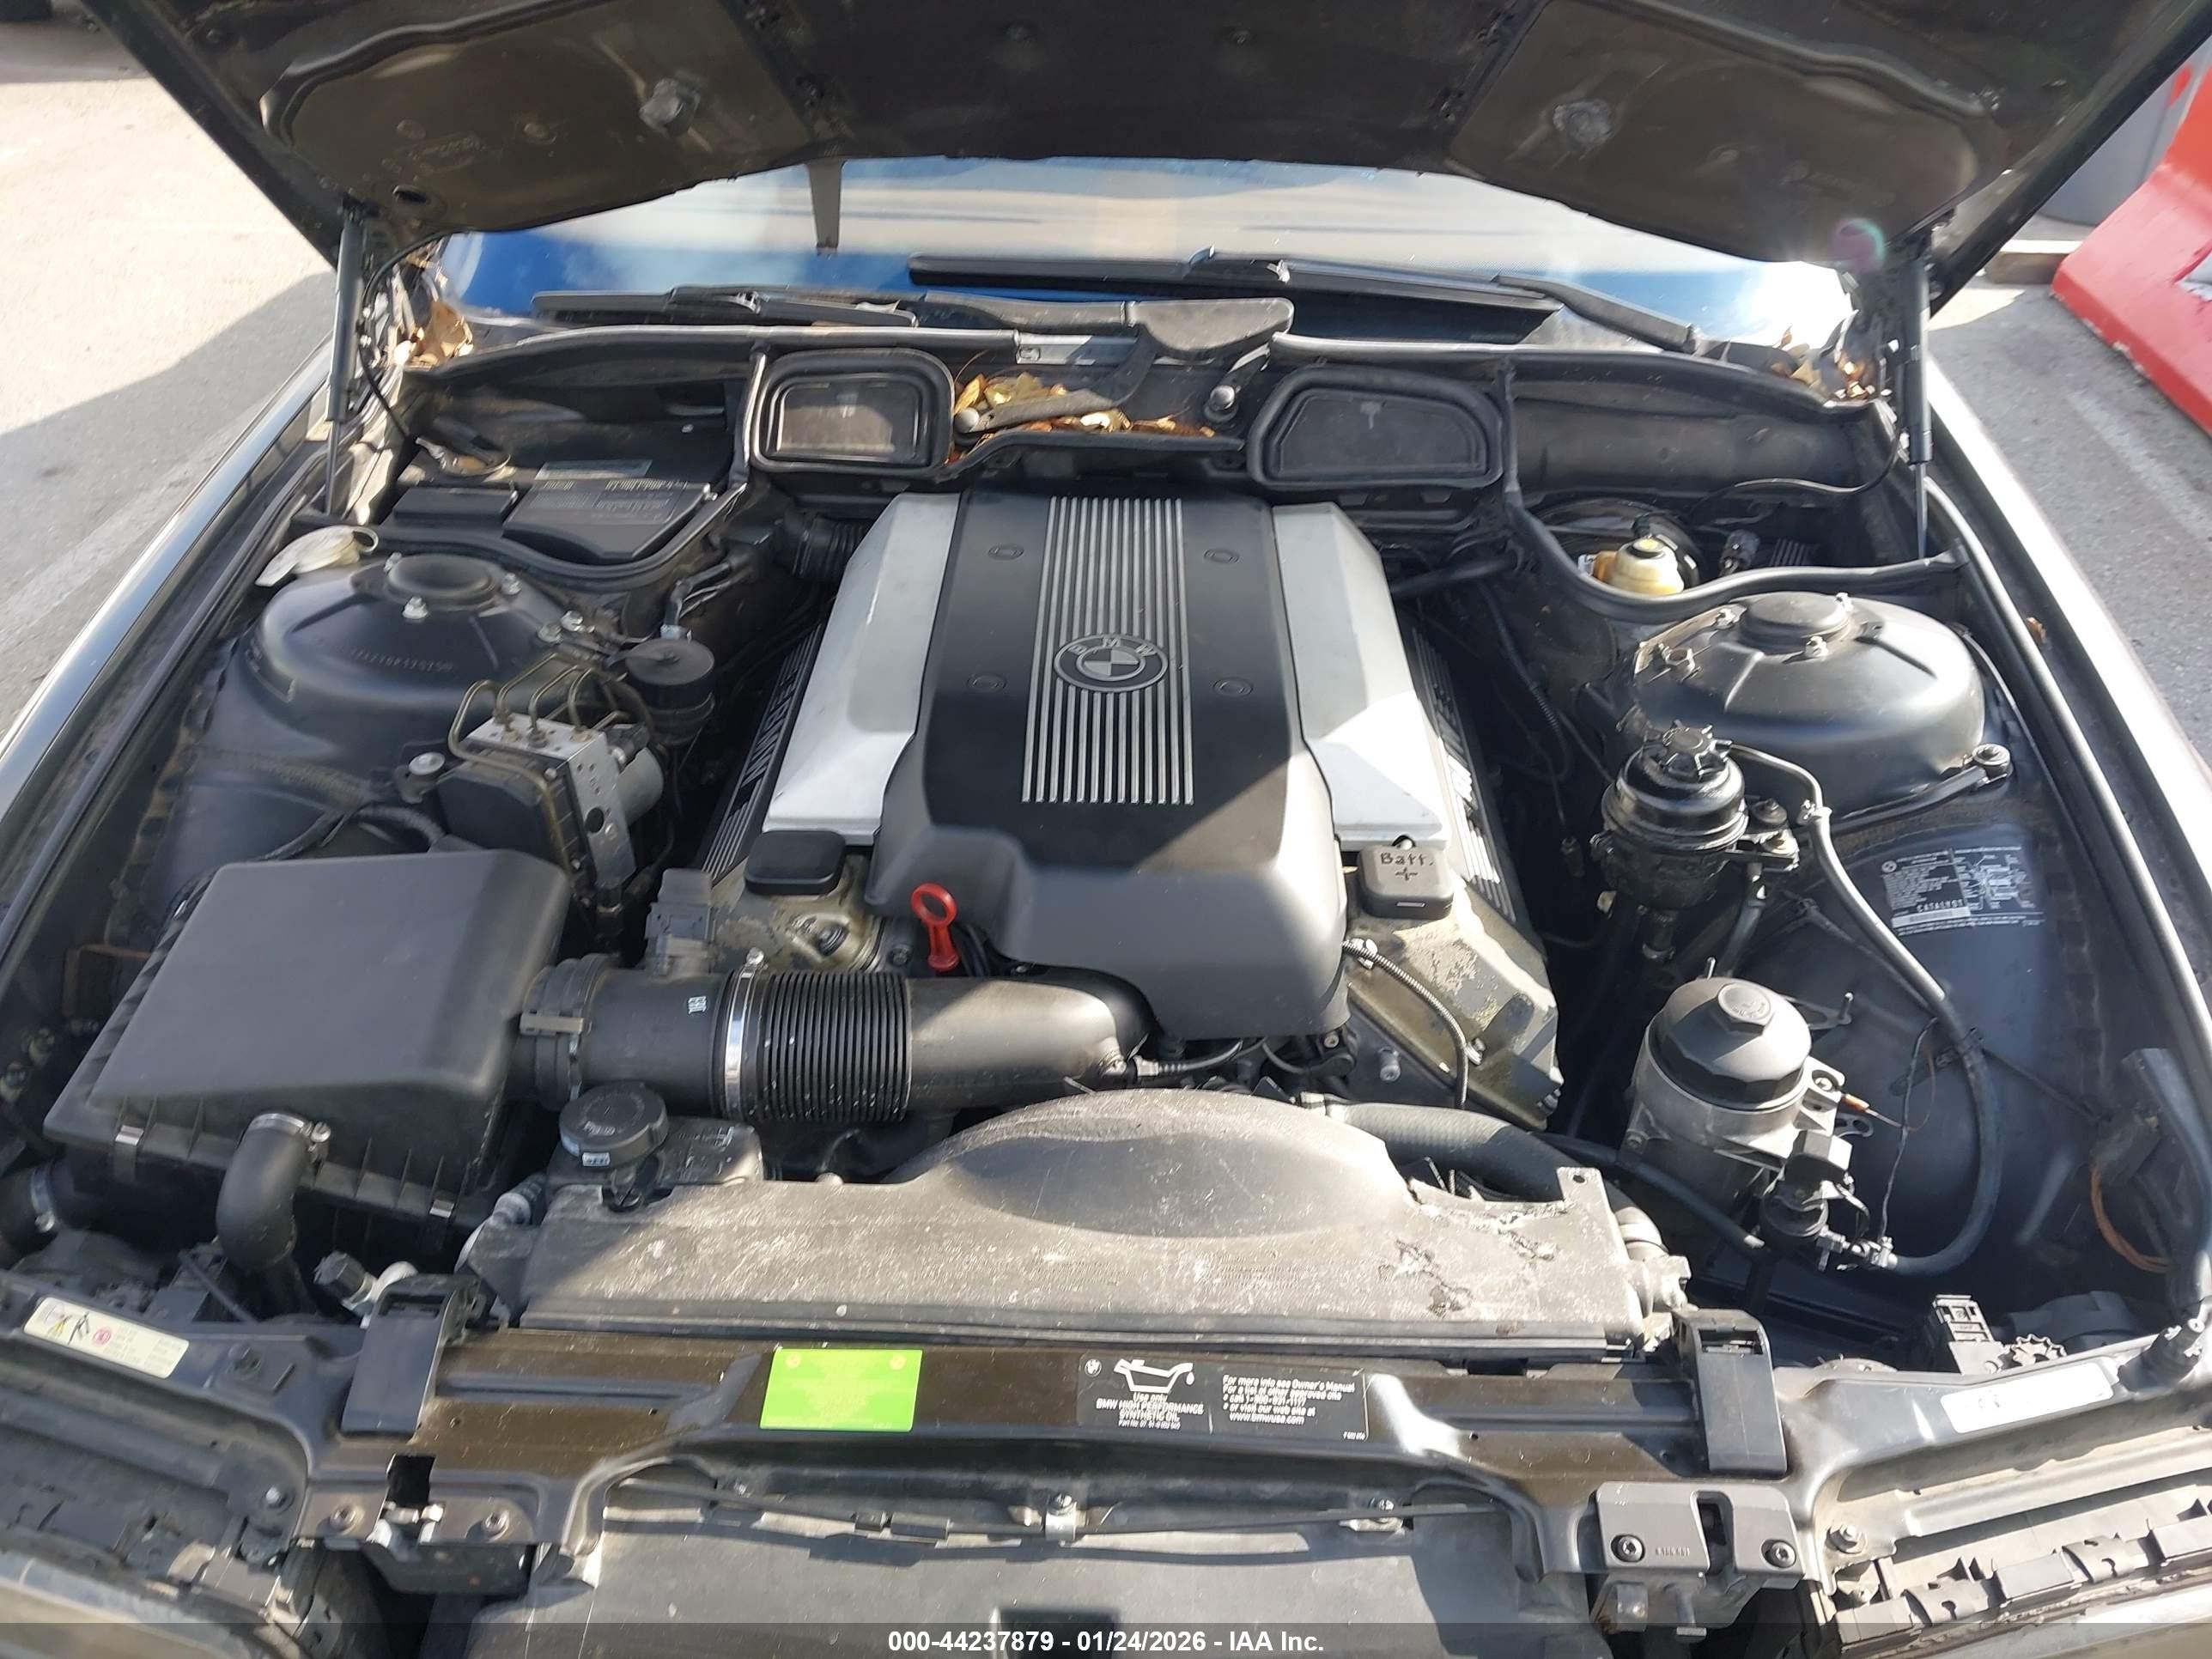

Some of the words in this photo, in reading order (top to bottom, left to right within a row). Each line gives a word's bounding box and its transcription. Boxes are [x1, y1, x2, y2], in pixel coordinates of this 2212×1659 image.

[1066, 636, 1157, 658] BMW
[1223, 1375, 1237, 1385] For
[1237, 1376, 1259, 1387] more
[1291, 1379, 1325, 1390] Owner's
[1325, 1381, 1356, 1394] Manual
[1223, 1384, 1237, 1394] For
[1096, 1397, 1119, 1410] BMW
[1140, 1401, 1205, 1415] PERFORMANCE
[1133, 1392, 1150, 1402] Use
